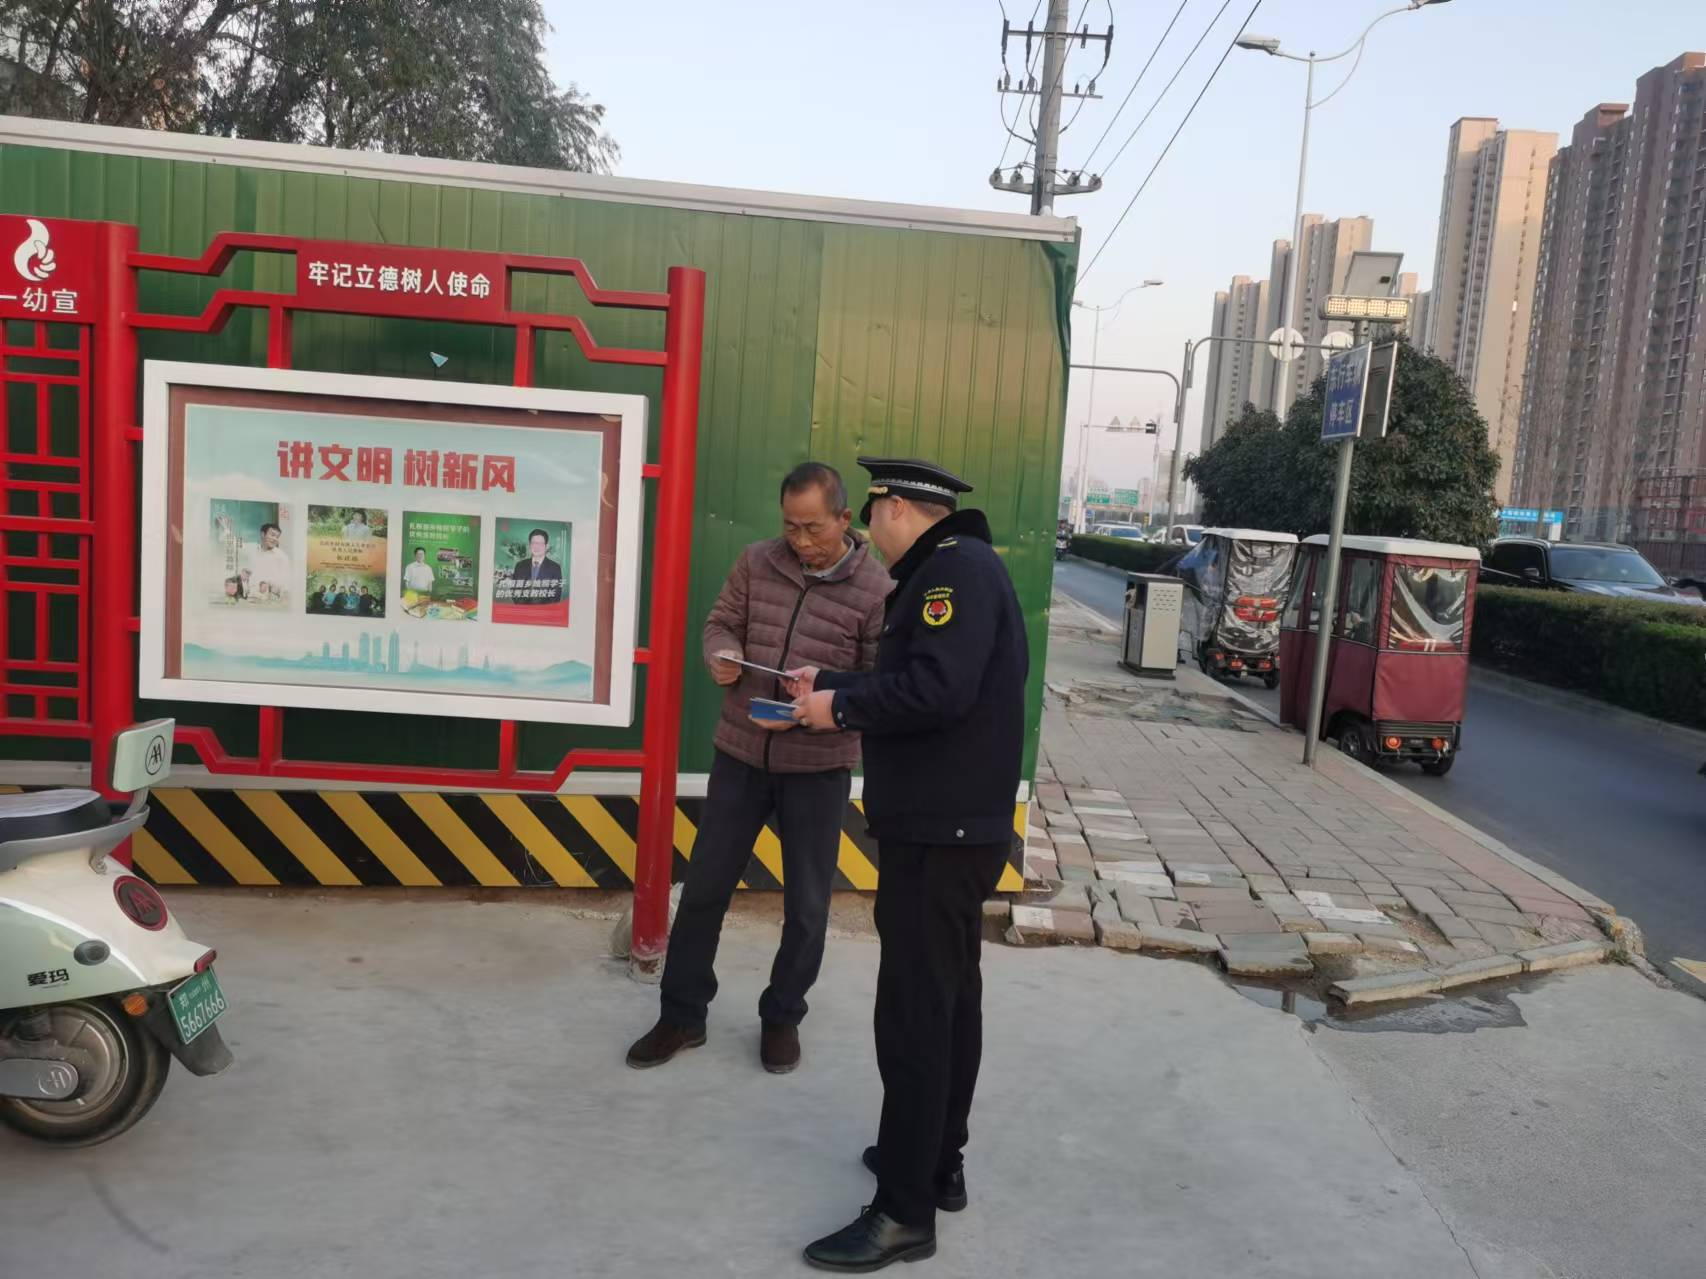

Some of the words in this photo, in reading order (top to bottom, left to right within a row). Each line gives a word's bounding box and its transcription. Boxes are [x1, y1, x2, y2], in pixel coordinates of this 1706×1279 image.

[308, 261, 491, 298] 牢记立德树人使命
[0, 287, 79, 314] 一幼宣
[277, 440, 394, 485] 讲文明
[403, 448, 516, 493] 树新风
[27, 968, 70, 987] 爱玛
[180, 990, 225, 1037] 5667666
